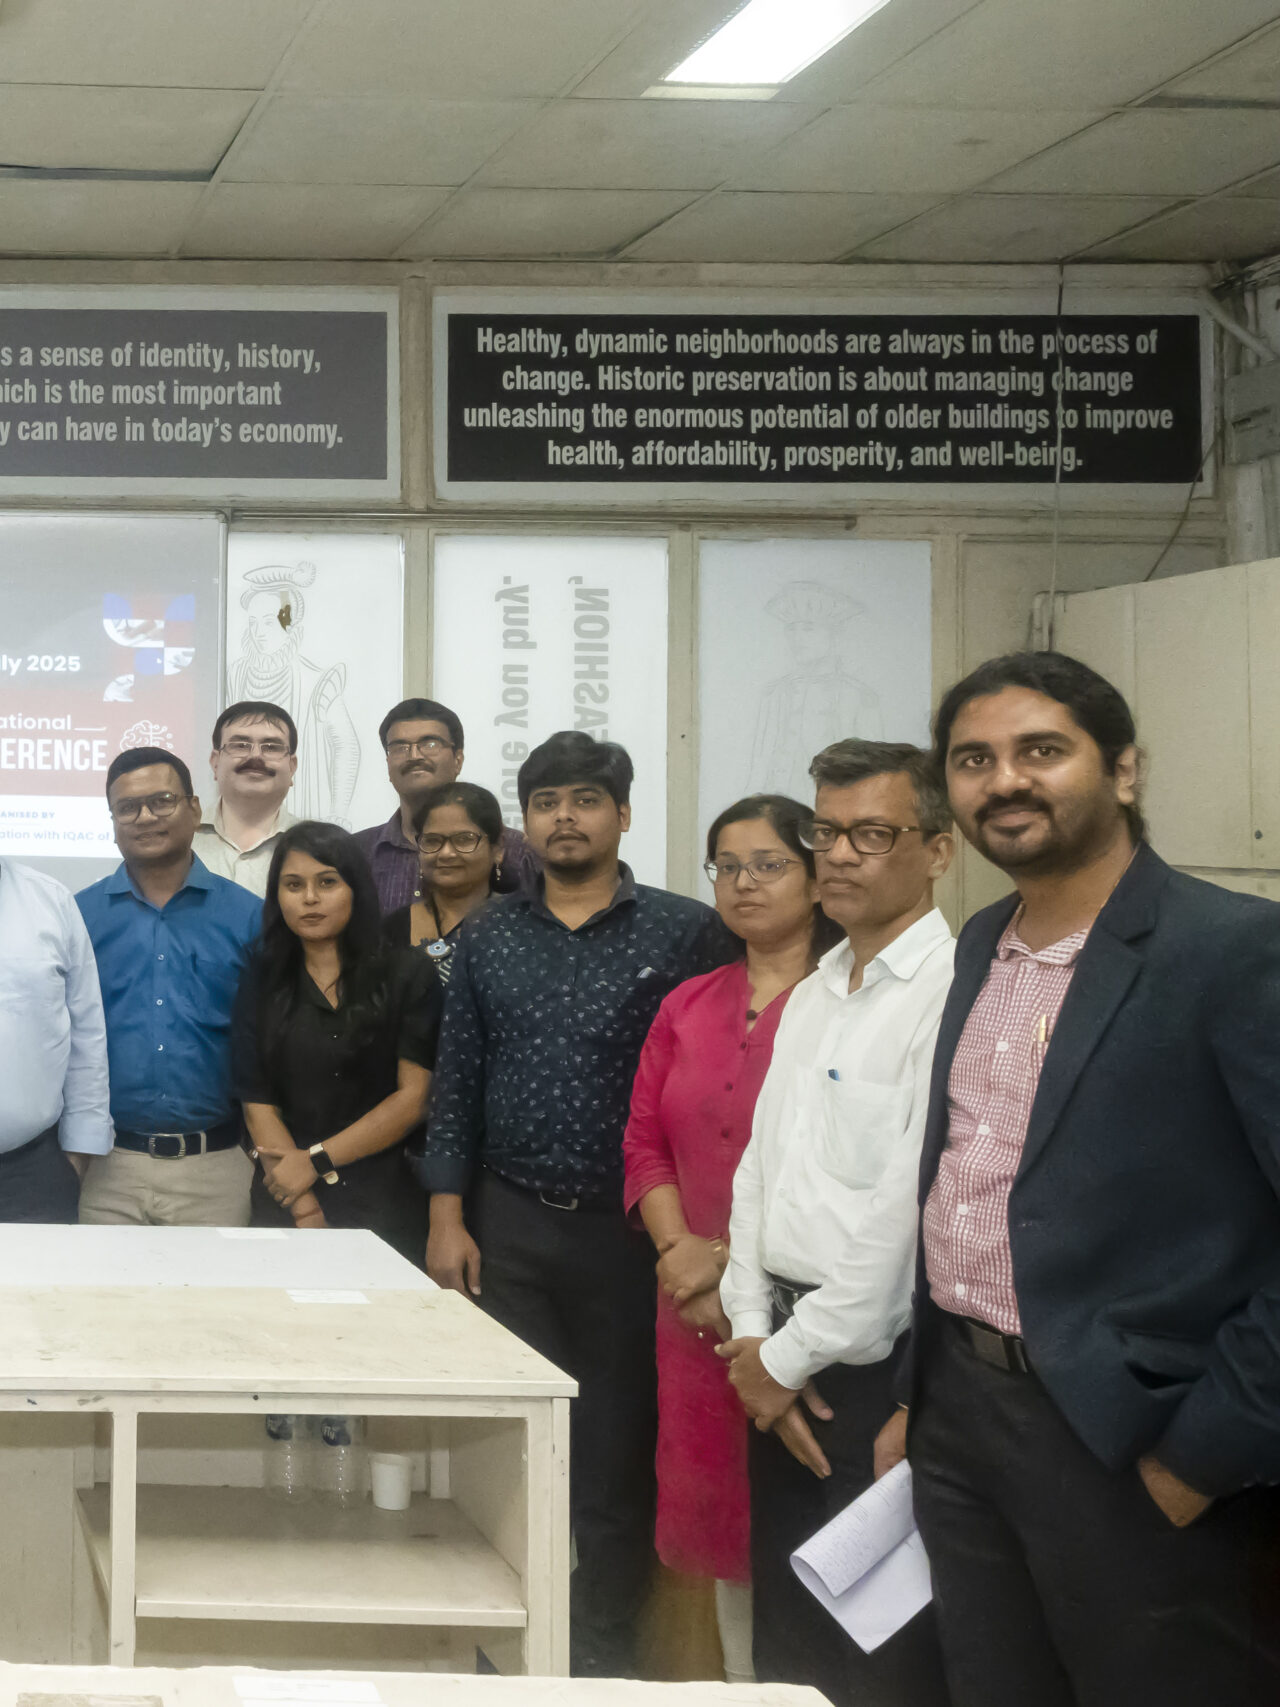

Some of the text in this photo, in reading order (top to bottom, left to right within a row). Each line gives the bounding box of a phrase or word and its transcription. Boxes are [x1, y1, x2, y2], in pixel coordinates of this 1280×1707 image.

[19, 346, 32, 366] a
[39, 346, 103, 366] sense
[110, 341, 132, 367] of
[139, 341, 230, 372] identity,
[237, 342, 320, 373] history,
[477, 326, 1157, 359] Healthy, dynamic neighborhoods are always in the process of
[44, 378, 62, 403] is
[68, 378, 104, 404] the
[111, 380, 166, 404] most
[173, 379, 281, 410] important
[502, 364, 1133, 396] change. Historic preservation is about managing change
[17, 420, 57, 440] can
[65, 415, 117, 441] have
[125, 416, 144, 441] in
[151, 416, 232, 447] today’s
[238, 423, 342, 448] economy.
[463, 401, 1172, 433] unleashing the enormous potential of older buildings to improve
[547, 439, 1083, 472] health, affordability, prosperity, and well-being.
[27, 656, 81, 672] 2025
[34, 830, 60, 841] with
[63, 832, 94, 843] IQAC
[98, 832, 110, 841] of
